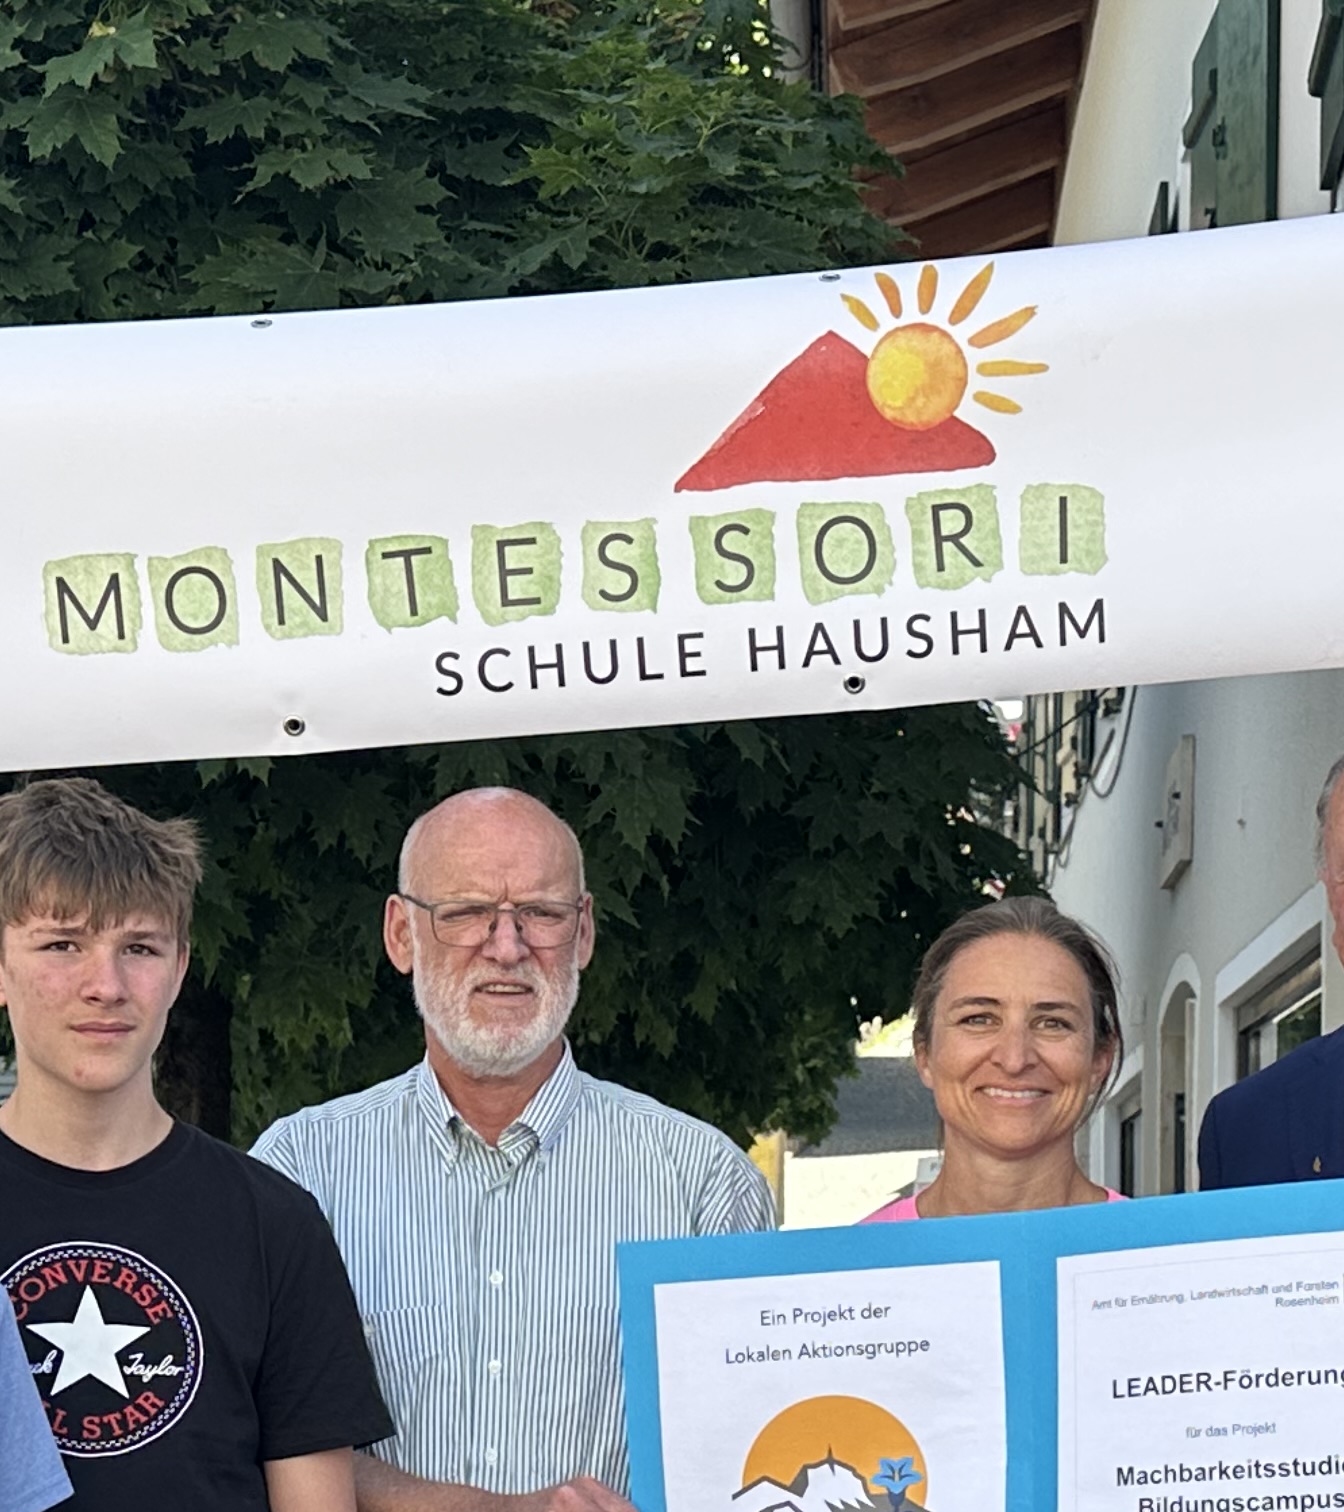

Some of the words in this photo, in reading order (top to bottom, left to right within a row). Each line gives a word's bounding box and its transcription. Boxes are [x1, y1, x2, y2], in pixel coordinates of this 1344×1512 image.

[55, 495, 1069, 645] MONTESSORI
[436, 631, 708, 697] SCHULE
[747, 598, 1107, 673] HAUSHAM
[1272, 1282, 1293, 1294] und
[1275, 1295, 1339, 1308] Rosenheim
[760, 1309, 787, 1327] Ein
[792, 1304, 856, 1328] Projekt
[860, 1302, 892, 1320] der
[725, 1344, 792, 1365] Lokalen
[797, 1338, 931, 1361] Aktionsgruppe
[122, 1352, 186, 1383] Taylor
[82, 1391, 166, 1439] STAR
[1186, 1426, 1202, 1440] für
[1205, 1425, 1228, 1437] das
[1231, 1423, 1276, 1438] Projekt
